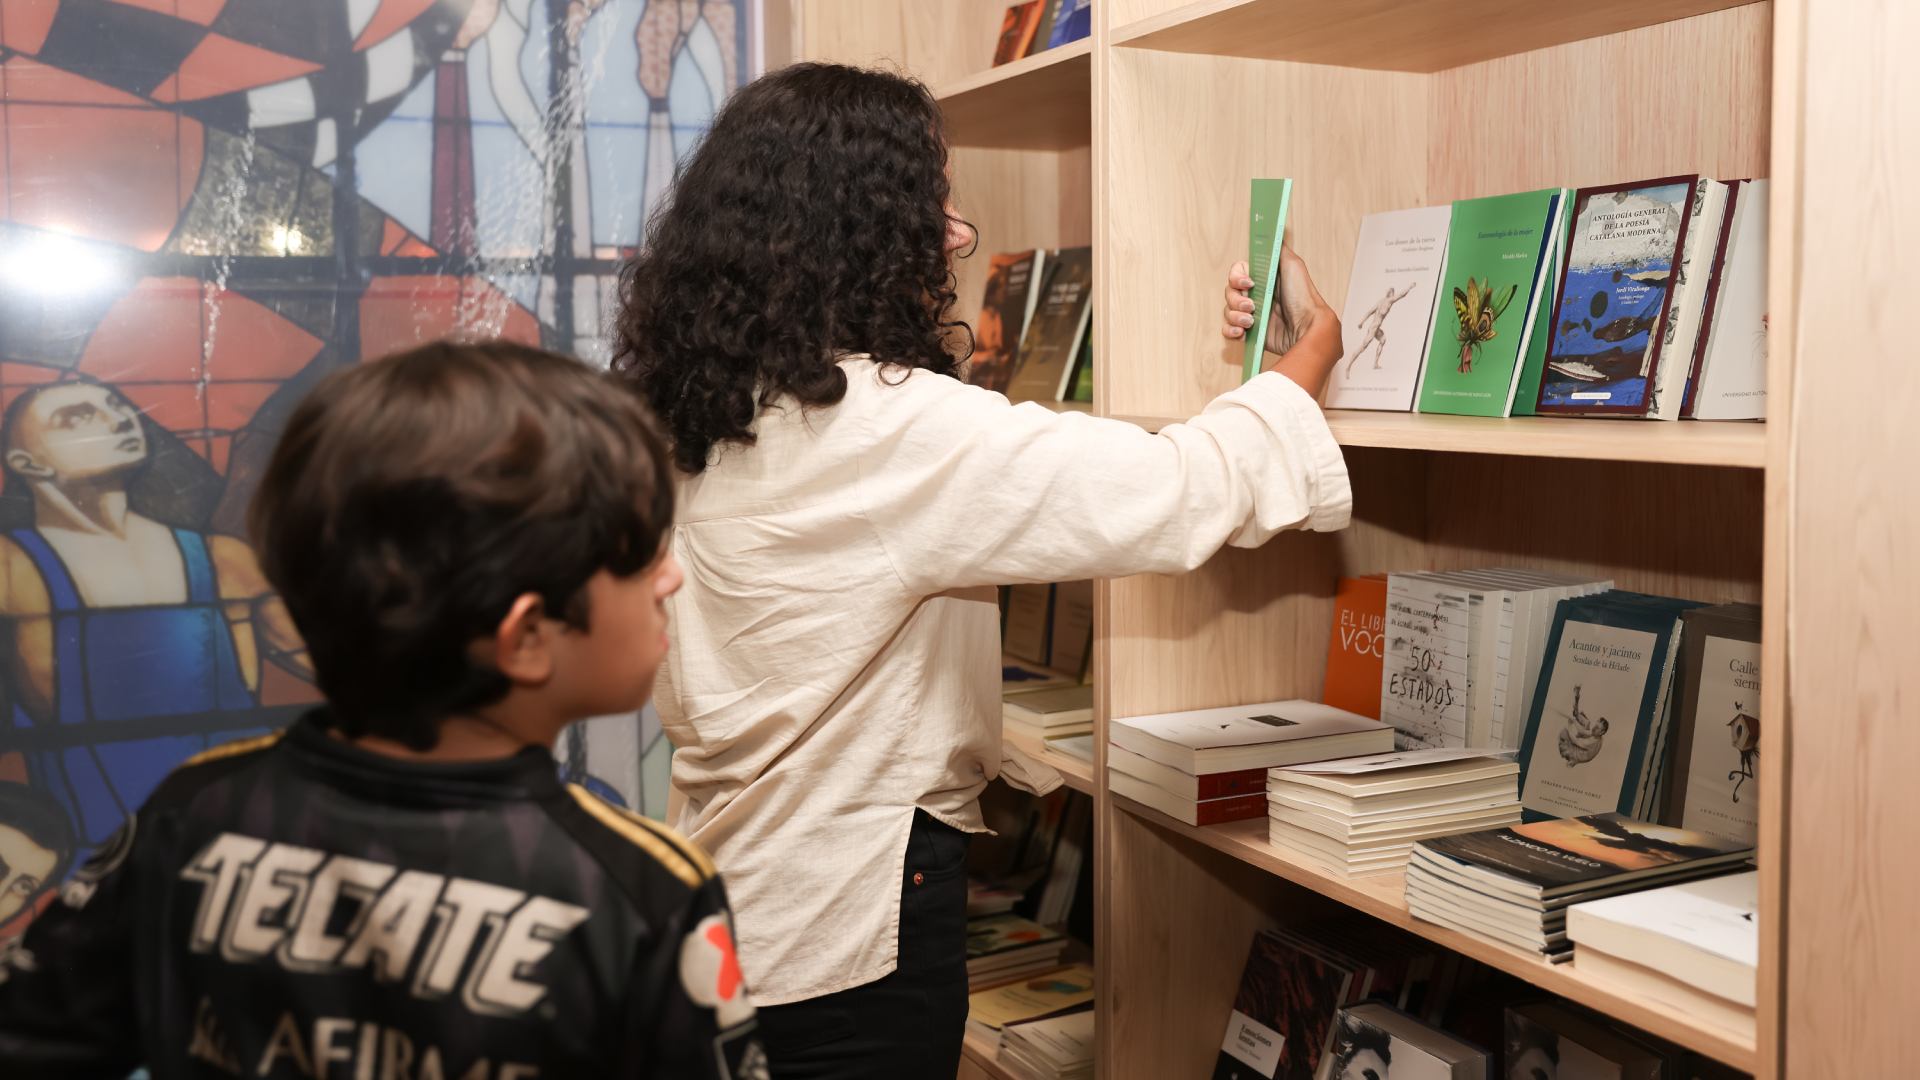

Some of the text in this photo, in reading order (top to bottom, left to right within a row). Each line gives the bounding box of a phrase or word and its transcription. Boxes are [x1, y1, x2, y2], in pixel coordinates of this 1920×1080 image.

[1592, 207, 1667, 222] ANTOLOGÍA GENERAL
[1604, 219, 1650, 231] DE LA POESÍA
[1589, 227, 1661, 241] CATALANA MODERNA
[1341, 609, 1357, 627] EL
[1411, 645, 1432, 672] 50
[1568, 638, 1601, 652] Acantos
[1606, 644, 1642, 660] jacintos
[1729, 658, 1759, 676] Calle
[1389, 673, 1453, 706] ESTADOS
[1733, 674, 1762, 696] siem
[181, 832, 591, 1017] TECATE
[256, 1010, 542, 1080] AFIRM
